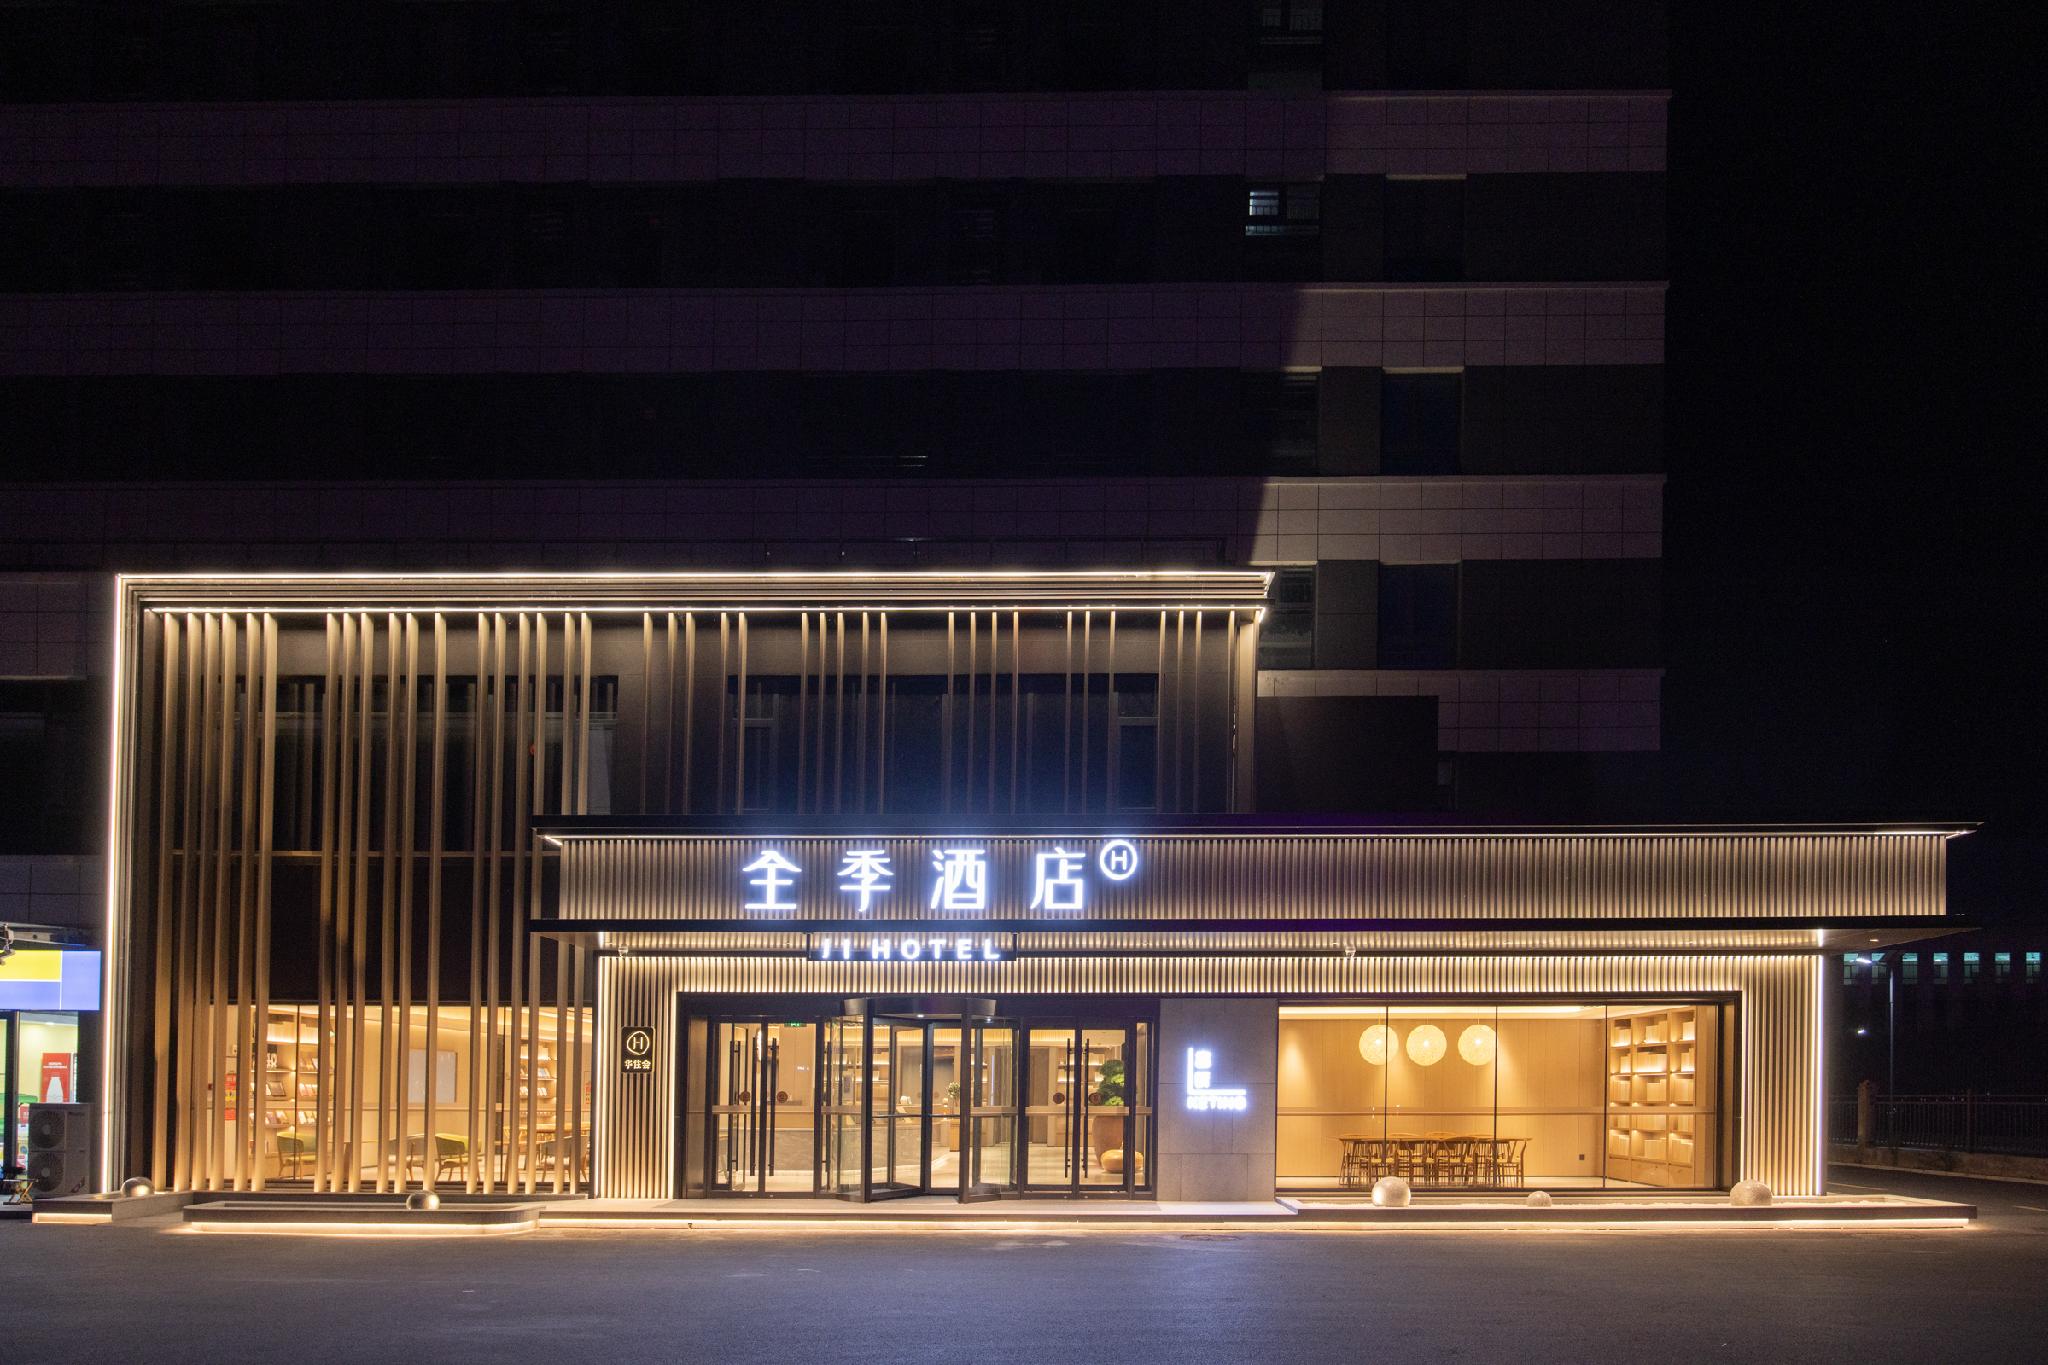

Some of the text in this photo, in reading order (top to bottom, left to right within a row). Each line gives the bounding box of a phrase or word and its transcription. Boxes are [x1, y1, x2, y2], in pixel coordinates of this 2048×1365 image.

[742, 846, 1086, 912] 全季酒店
[822, 938, 1000, 960] JI HOTEL
